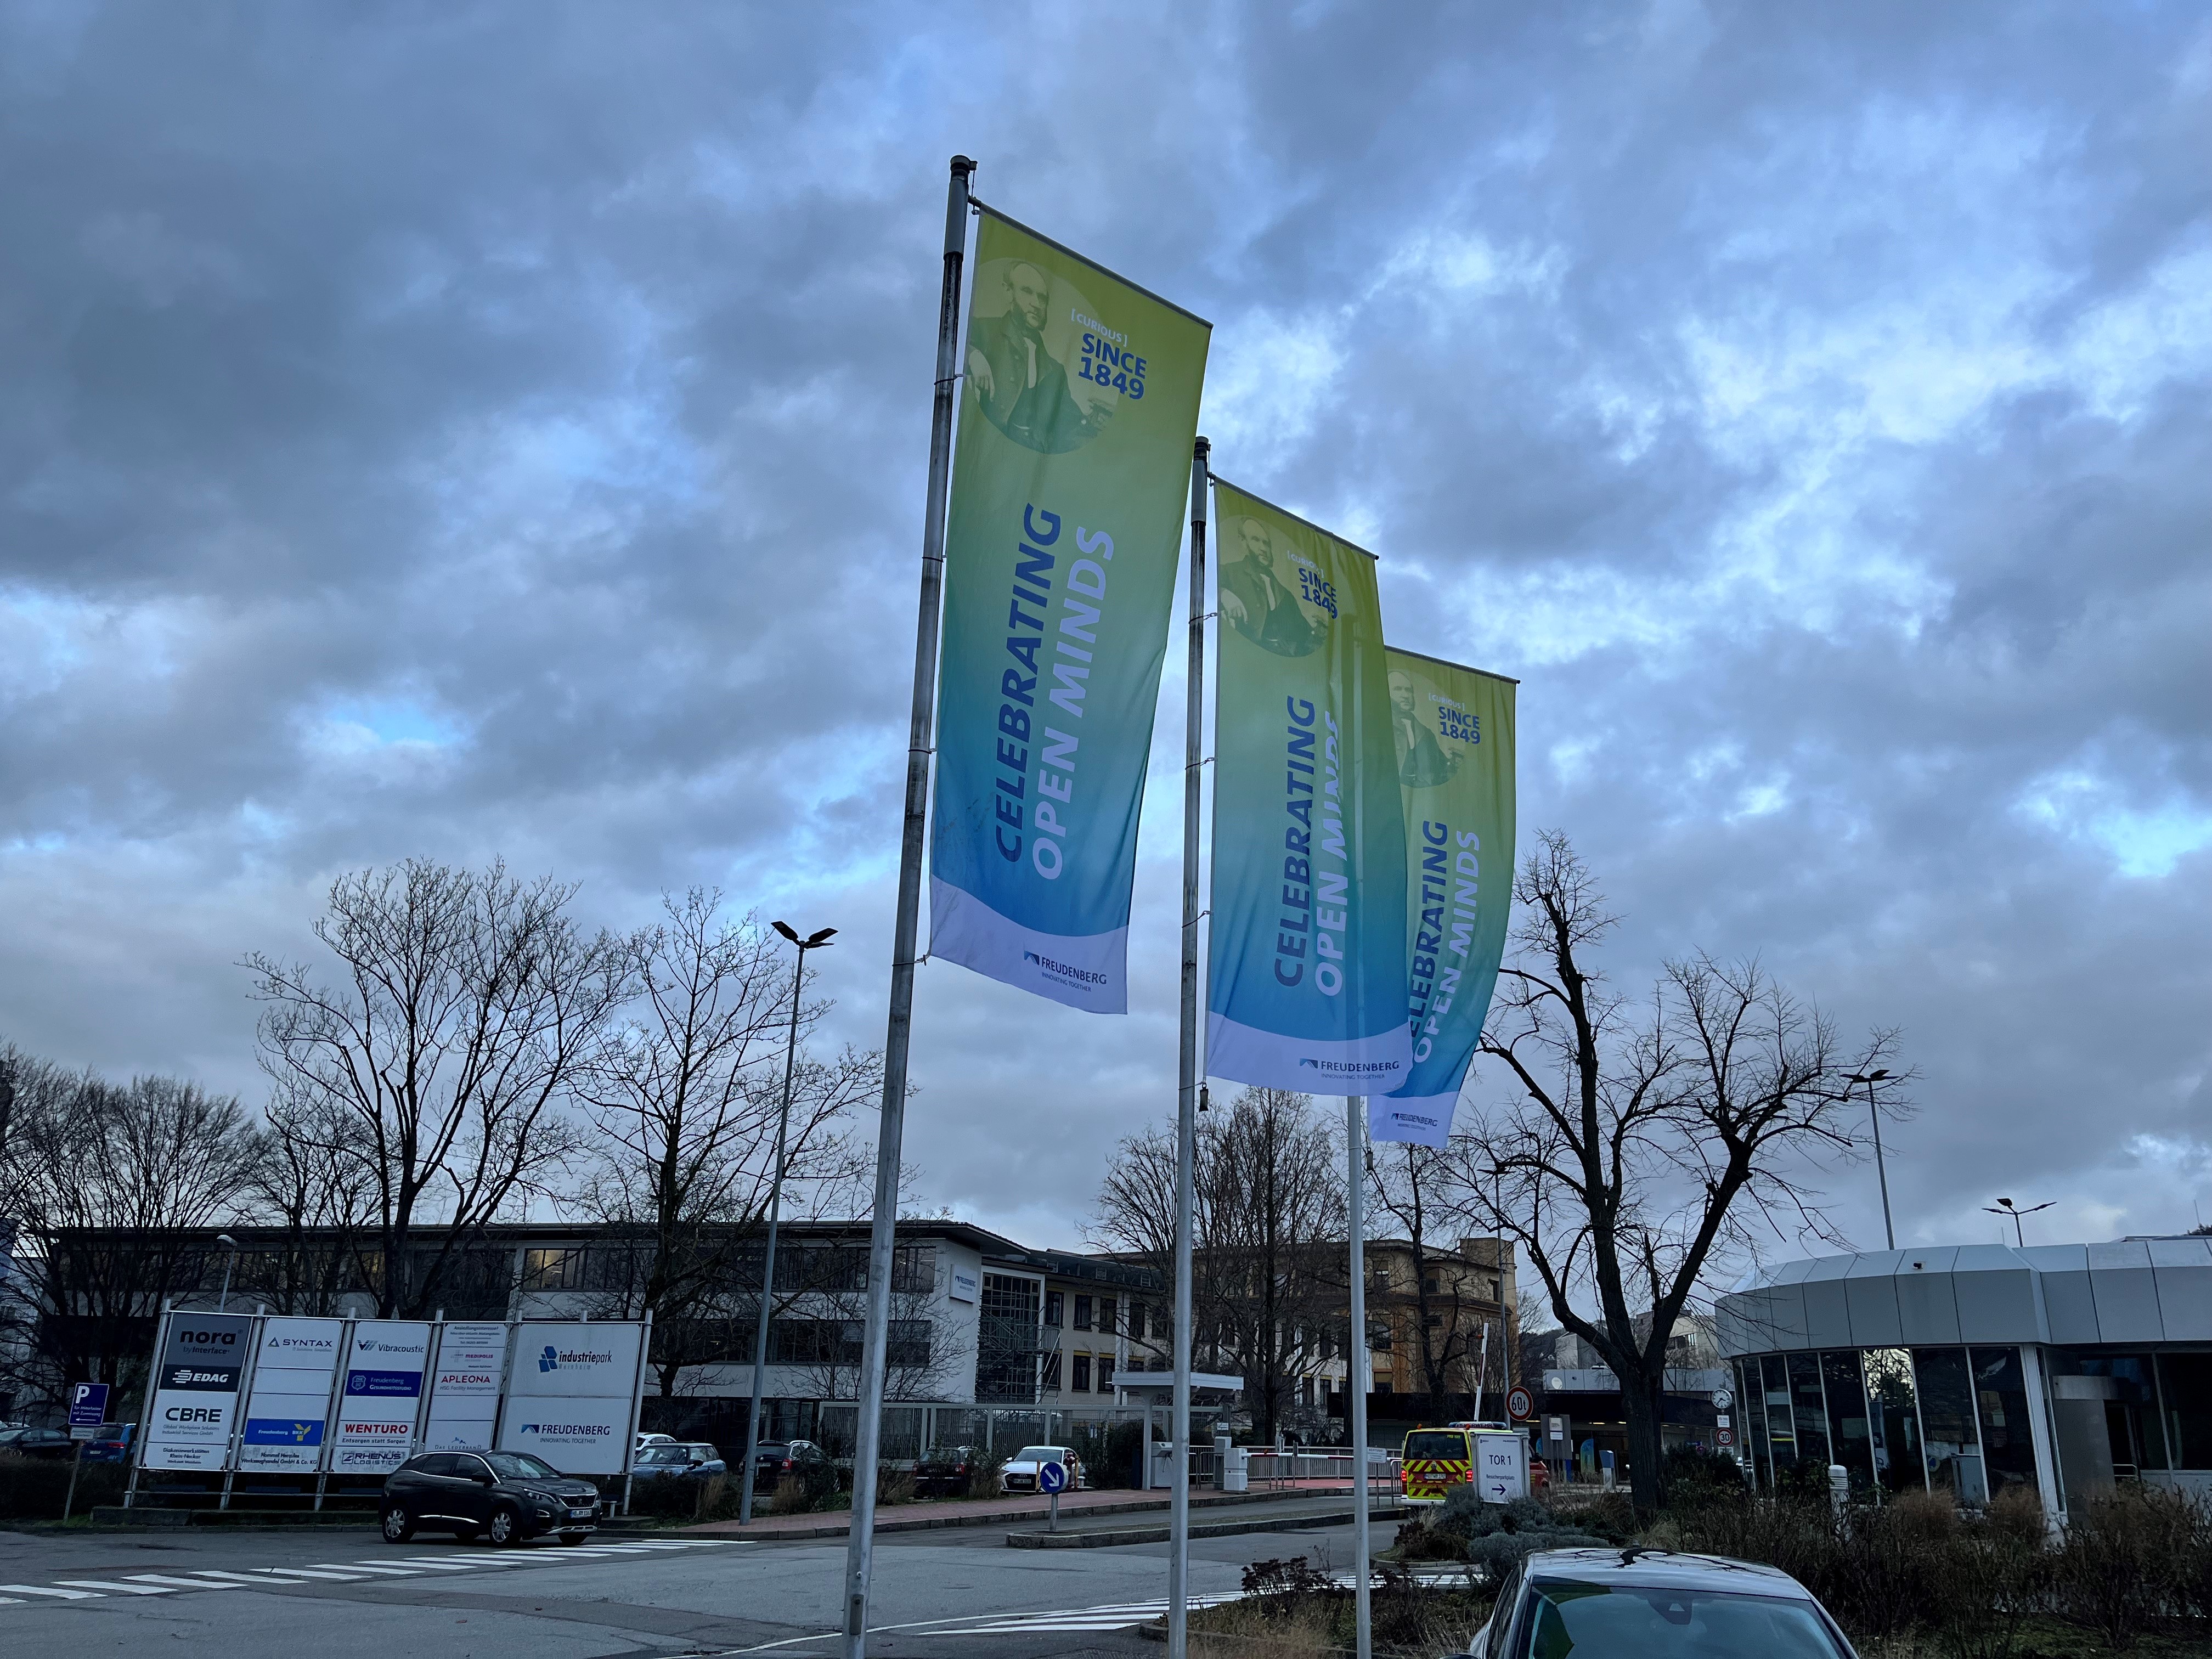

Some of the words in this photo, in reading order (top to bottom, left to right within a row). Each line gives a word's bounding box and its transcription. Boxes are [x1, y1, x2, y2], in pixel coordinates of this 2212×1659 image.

[1081, 333, 1147, 380] SINCE
[1078, 357, 1144, 400] 1849
[1299, 567, 1338, 603] SINCE
[1301, 584, 1338, 619] 1849
[1049, 526, 1114, 718] MINDS
[996, 503, 1061, 862] CELEBRATING
[1438, 706, 1480, 730] SINCE
[1440, 721, 1481, 744] 1849
[1032, 727, 1079, 880] OPEN
[1275, 695, 1316, 987] CELEBRATING
[1448, 831, 1480, 958] MINDS
[1316, 870, 1348, 997] OPEN
[1408, 820, 1448, 1039] ELEBRATING
[1041, 956, 1107, 985] FREUDENBERG
[1041, 972, 1068, 986] INNOVATING
[1068, 980, 1092, 992] TOGETHER
[1414, 966, 1462, 1063] OPEN
[1321, 1060, 1400, 1072] FREUDENBERG
[180, 1330, 236, 1345] nora
[283, 1339, 332, 1347] SYNTAX
[379, 1344, 424, 1353] Vibracoustic
[558, 1350, 612, 1365] industriepark
[192, 1373, 229, 1383] EDAG
[75, 1385, 90, 1404] P
[165, 1408, 223, 1423] CBRE
[345, 1424, 408, 1434] WENTURO
[541, 1424, 611, 1435] FREUDENBERG
[1488, 1454, 1506, 1465] TOR
[1507, 1455, 1512, 1465] 1
